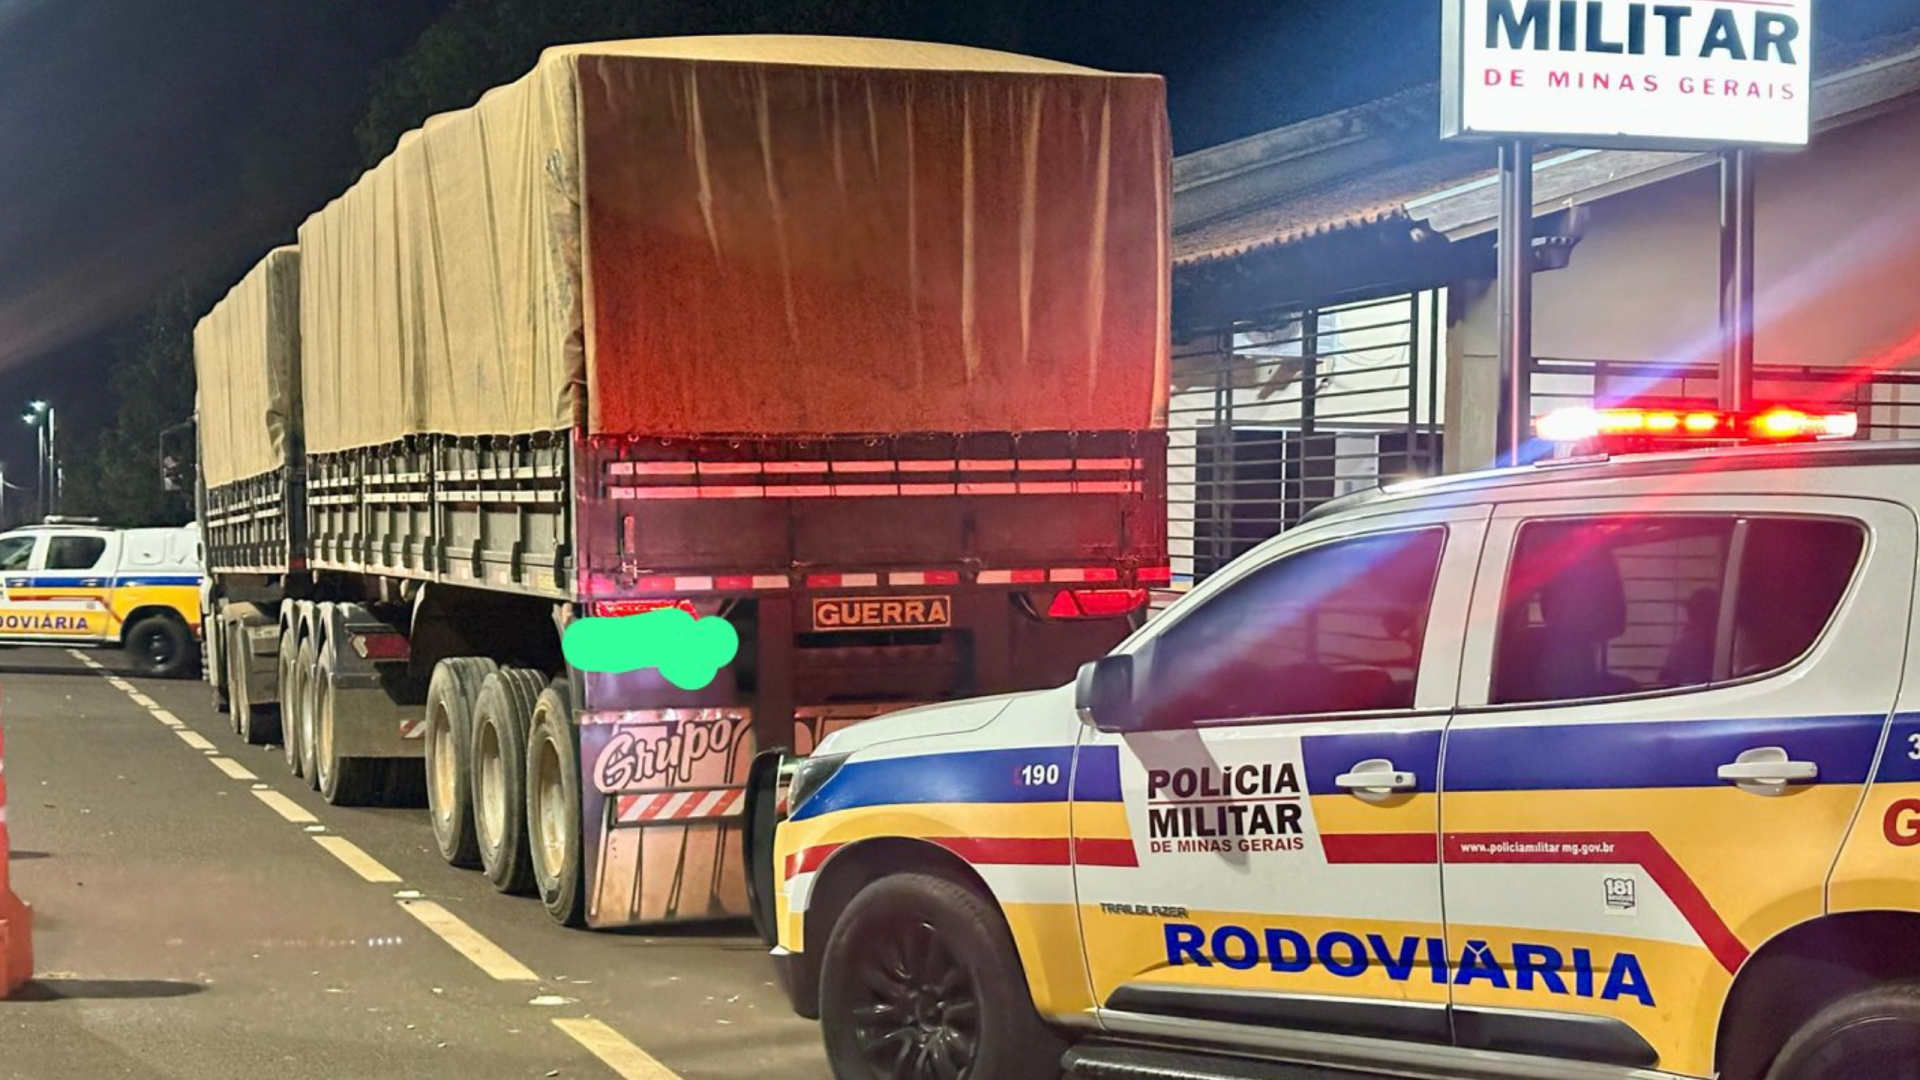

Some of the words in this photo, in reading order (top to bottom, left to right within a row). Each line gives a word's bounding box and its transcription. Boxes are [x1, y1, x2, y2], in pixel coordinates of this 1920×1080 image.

[1485, 0, 1799, 64] MILITAR
[1484, 69, 1525, 87] DE
[1548, 71, 1659, 92] MINAS
[1679, 76, 1795, 100] GERAIS
[816, 600, 947, 625] GUERRA
[593, 719, 733, 793] Grupo
[1022, 764, 1059, 785] 190
[1148, 803, 1303, 838] MILITAR
[1150, 840, 1172, 853] DE
[1178, 839, 1232, 853] MINAS
[1238, 837, 1304, 851] GERAIS
[1604, 878, 1635, 896] 181
[1163, 922, 1657, 1007] RODOVIÁRIA
